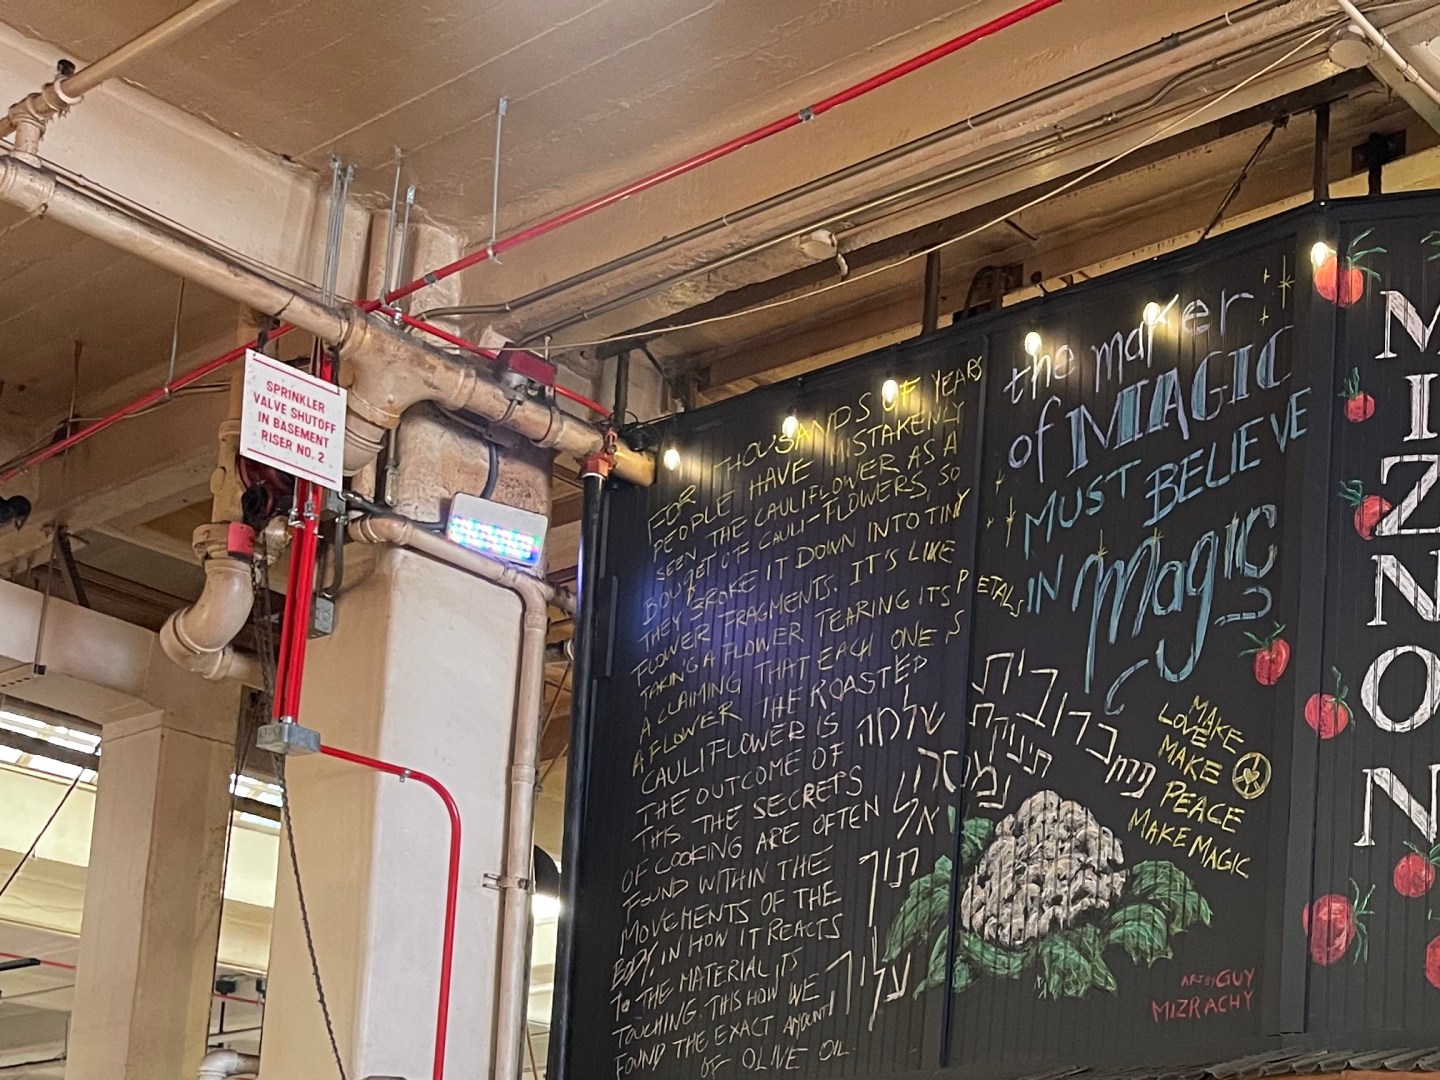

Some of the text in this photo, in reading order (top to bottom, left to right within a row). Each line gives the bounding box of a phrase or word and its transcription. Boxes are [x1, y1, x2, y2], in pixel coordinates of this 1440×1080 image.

[253, 392, 337, 434] VALVE SHUTOFF
[266, 381, 325, 414] SPRINKLER
[1003, 352, 1075, 404] the
[1008, 325, 1296, 483] of MAGIC
[257, 411, 329, 448] IN BASEMENT
[261, 430, 325, 463] RISER NO. 2
[647, 485, 697, 544] FOR
[932, 355, 983, 403] YEARS
[652, 401, 964, 562] PEOPLE HAVE MISTAKENLY
[656, 431, 958, 581] SEEN THE CAULIFLOWER AS A
[1024, 388, 1312, 561] MUST BELIEVE
[720, 546, 750, 570] OF
[938, 466, 961, 485] SO
[640, 488, 971, 654] THEY BROKE IT DOWN INTO TINY
[1026, 554, 1064, 614] IN
[632, 625, 711, 686] FLOWER
[851, 546, 898, 586] IT'S
[908, 540, 956, 564] LIKE
[724, 584, 951, 667] FLOWER TEARING ITS
[647, 654, 928, 761] FLOWER THE ROASTED
[658, 625, 938, 724] CLAIMING THAT EACH ONE
[641, 711, 840, 795] CAULIFLOWER IS
[1158, 701, 1209, 749] LOVE
[1158, 734, 1223, 785] MAKE
[1189, 695, 1244, 754] MAKE
[636, 743, 845, 826] THE OUTCOME OF
[692, 765, 863, 835] THE SECRETS
[1160, 780, 1245, 833] PEACE
[655, 795, 880, 875] COOKING ARE OFTEN
[1128, 807, 1251, 879] MAKE MAGIC
[619, 880, 842, 955] MOVEMENTS OF THE
[623, 846, 835, 923] FOUND WITHIN THE
[688, 913, 844, 960] HOW IT REACTS
[679, 955, 770, 993] MATERIAL
[704, 991, 742, 1021] THIS
[1151, 990, 1255, 1024] MIZRACHY
[1216, 967, 1255, 988] GUY
[672, 1030, 709, 1060] THE
[715, 1013, 774, 1046] EXACT
[700, 1045, 808, 1080] OF OLIVE
